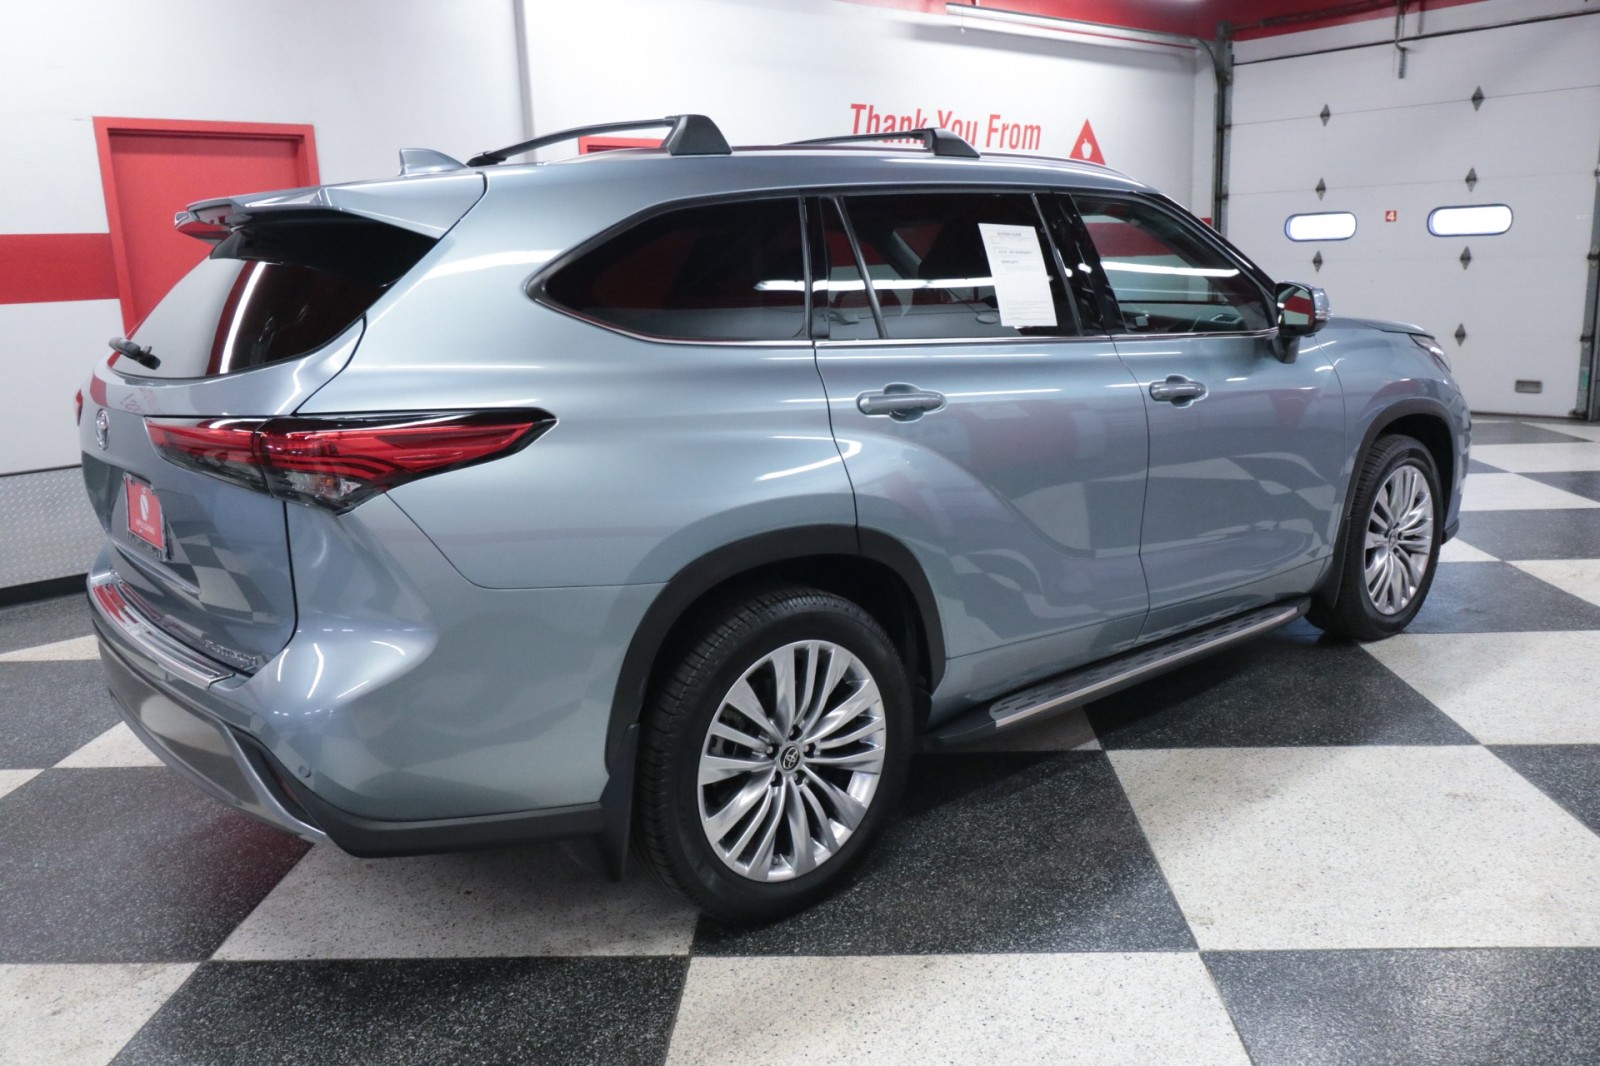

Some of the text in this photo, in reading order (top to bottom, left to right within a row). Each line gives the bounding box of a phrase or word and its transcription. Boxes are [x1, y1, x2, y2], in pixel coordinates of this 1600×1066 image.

[851, 104, 928, 145] Thank
[985, 114, 1042, 150] From
[1386, 210, 1396, 222] 4
